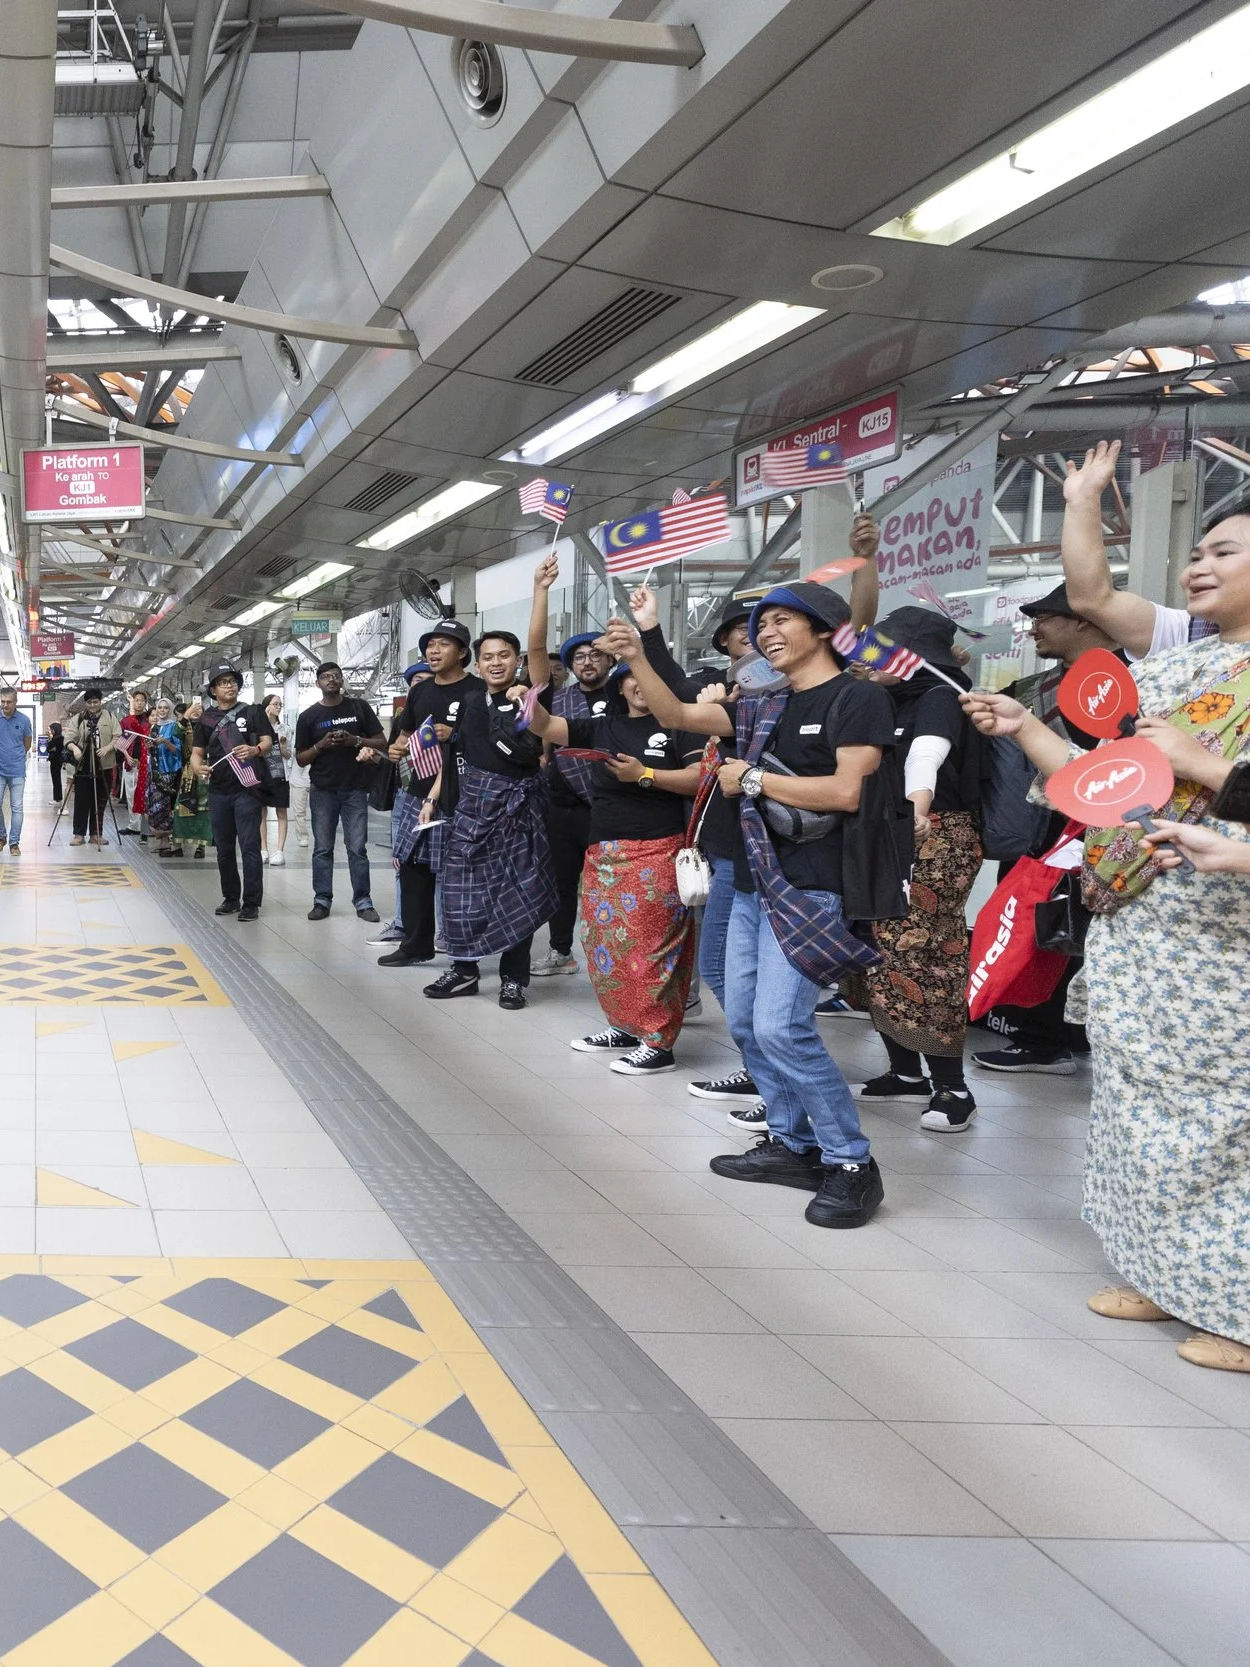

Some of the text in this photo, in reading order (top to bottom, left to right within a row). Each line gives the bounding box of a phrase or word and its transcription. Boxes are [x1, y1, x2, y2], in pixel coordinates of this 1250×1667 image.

[862, 412, 889, 433] KJ15
[793, 419, 840, 448] Sentral
[42, 452, 120, 470] Platform 1
[55, 471, 110, 482] Ke arah TO
[73, 483, 91, 492] KJ1
[59, 493, 107, 505] Gombak
[878, 488, 983, 545] emput
[878, 552, 981, 590] acam-macam ada
[294, 621, 328, 632] KELUAR
[332, 716, 357, 725] teleport
